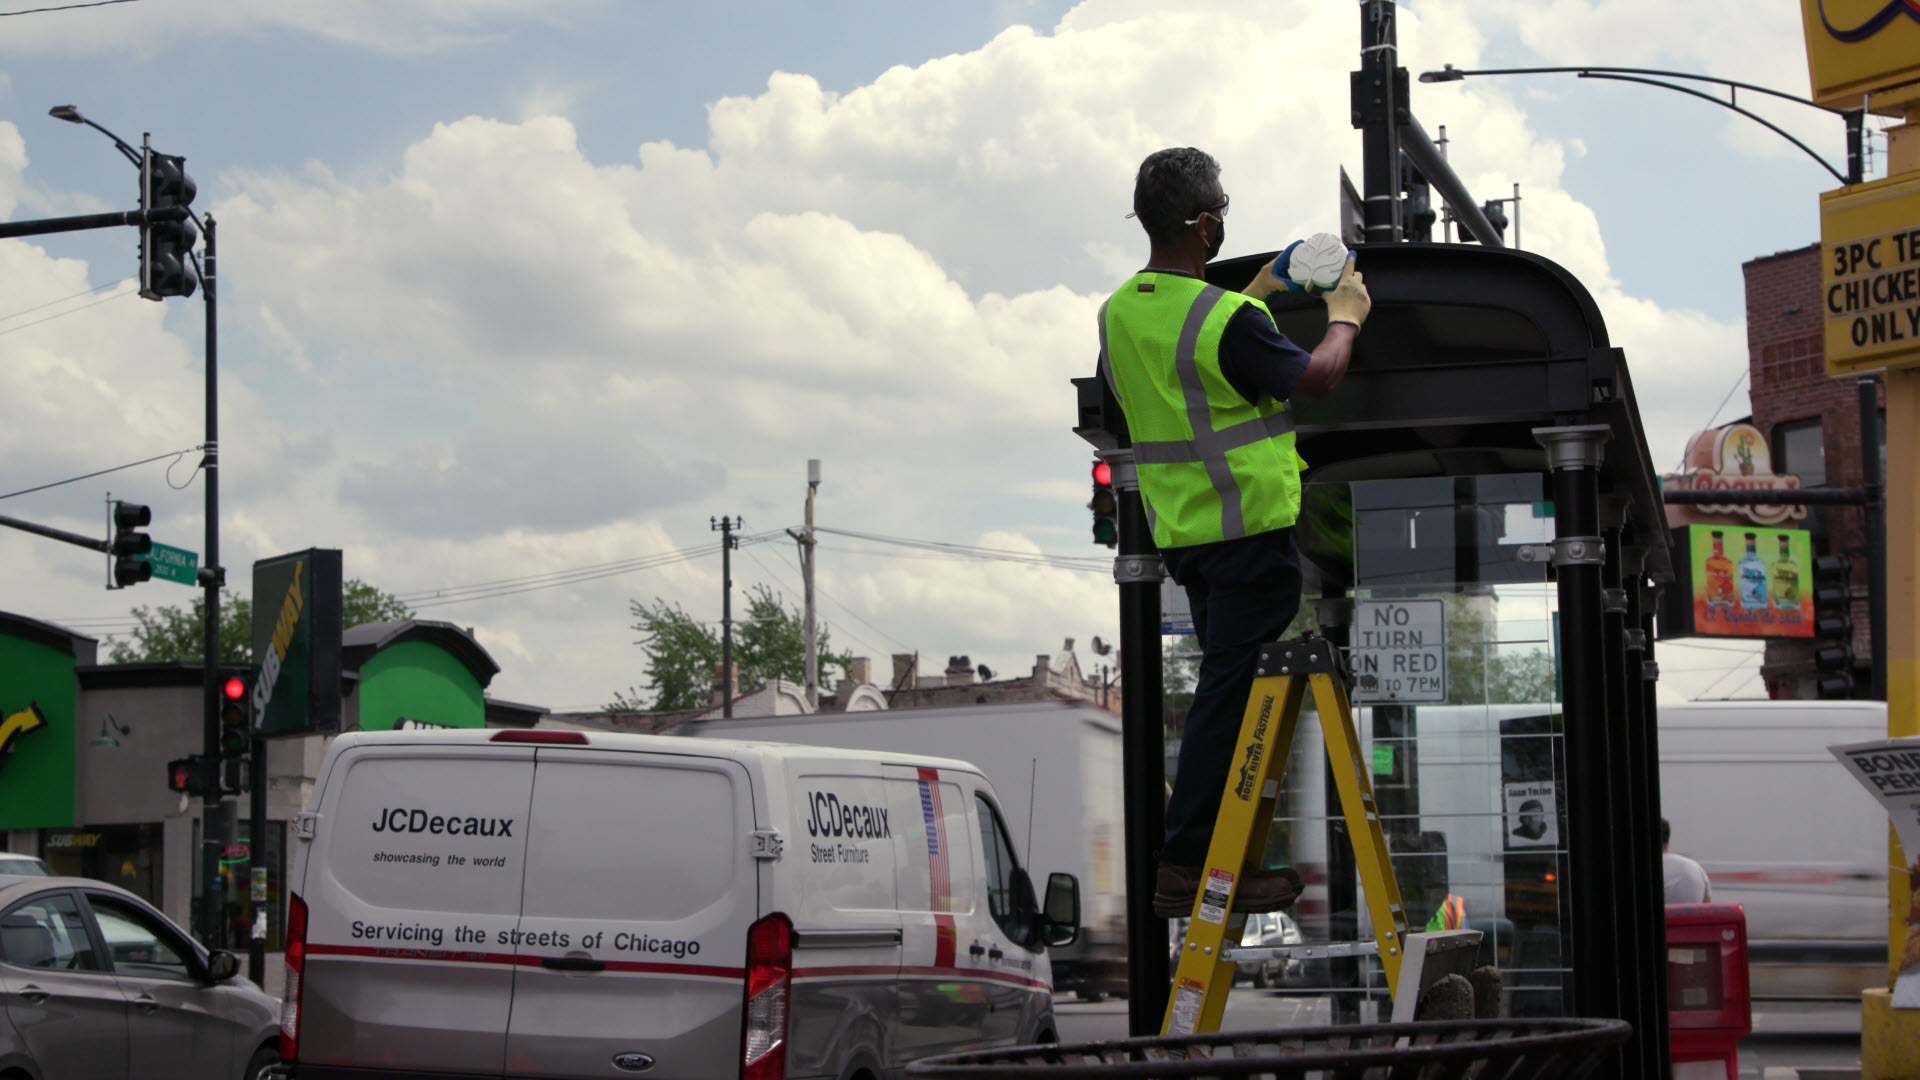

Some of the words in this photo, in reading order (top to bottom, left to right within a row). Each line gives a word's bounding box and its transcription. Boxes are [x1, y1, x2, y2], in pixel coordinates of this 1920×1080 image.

[1834, 238, 1882, 276] 3PC
[1828, 268, 1920, 313] CHICKE
[1852, 306, 1920, 347] ONLY
[1374, 607, 1409, 626] NO
[252, 561, 304, 729] SUBWAY
[1362, 630, 1423, 649] TURN
[1349, 654, 1378, 673] ON
[1393, 653, 1437, 673] RED
[1385, 679, 1402, 691] TO
[1253, 695, 1275, 742] FASTENAL
[1241, 774, 1256, 801] ROCK
[1249, 744, 1264, 772] RIVER
[372, 808, 514, 837] JCDecaux
[807, 791, 891, 839] JCDecaux
[48, 834, 101, 848] SUBWAY
[811, 843, 835, 863] Street
[838, 843, 869, 863] Furniture
[373, 852, 440, 867] showcasing
[447, 855, 466, 866] the
[473, 857, 506, 868] world
[351, 921, 443, 946] Servicing
[455, 925, 486, 943] the
[497, 928, 570, 947] streets
[582, 932, 603, 949] of
[614, 932, 701, 959] Chicago
